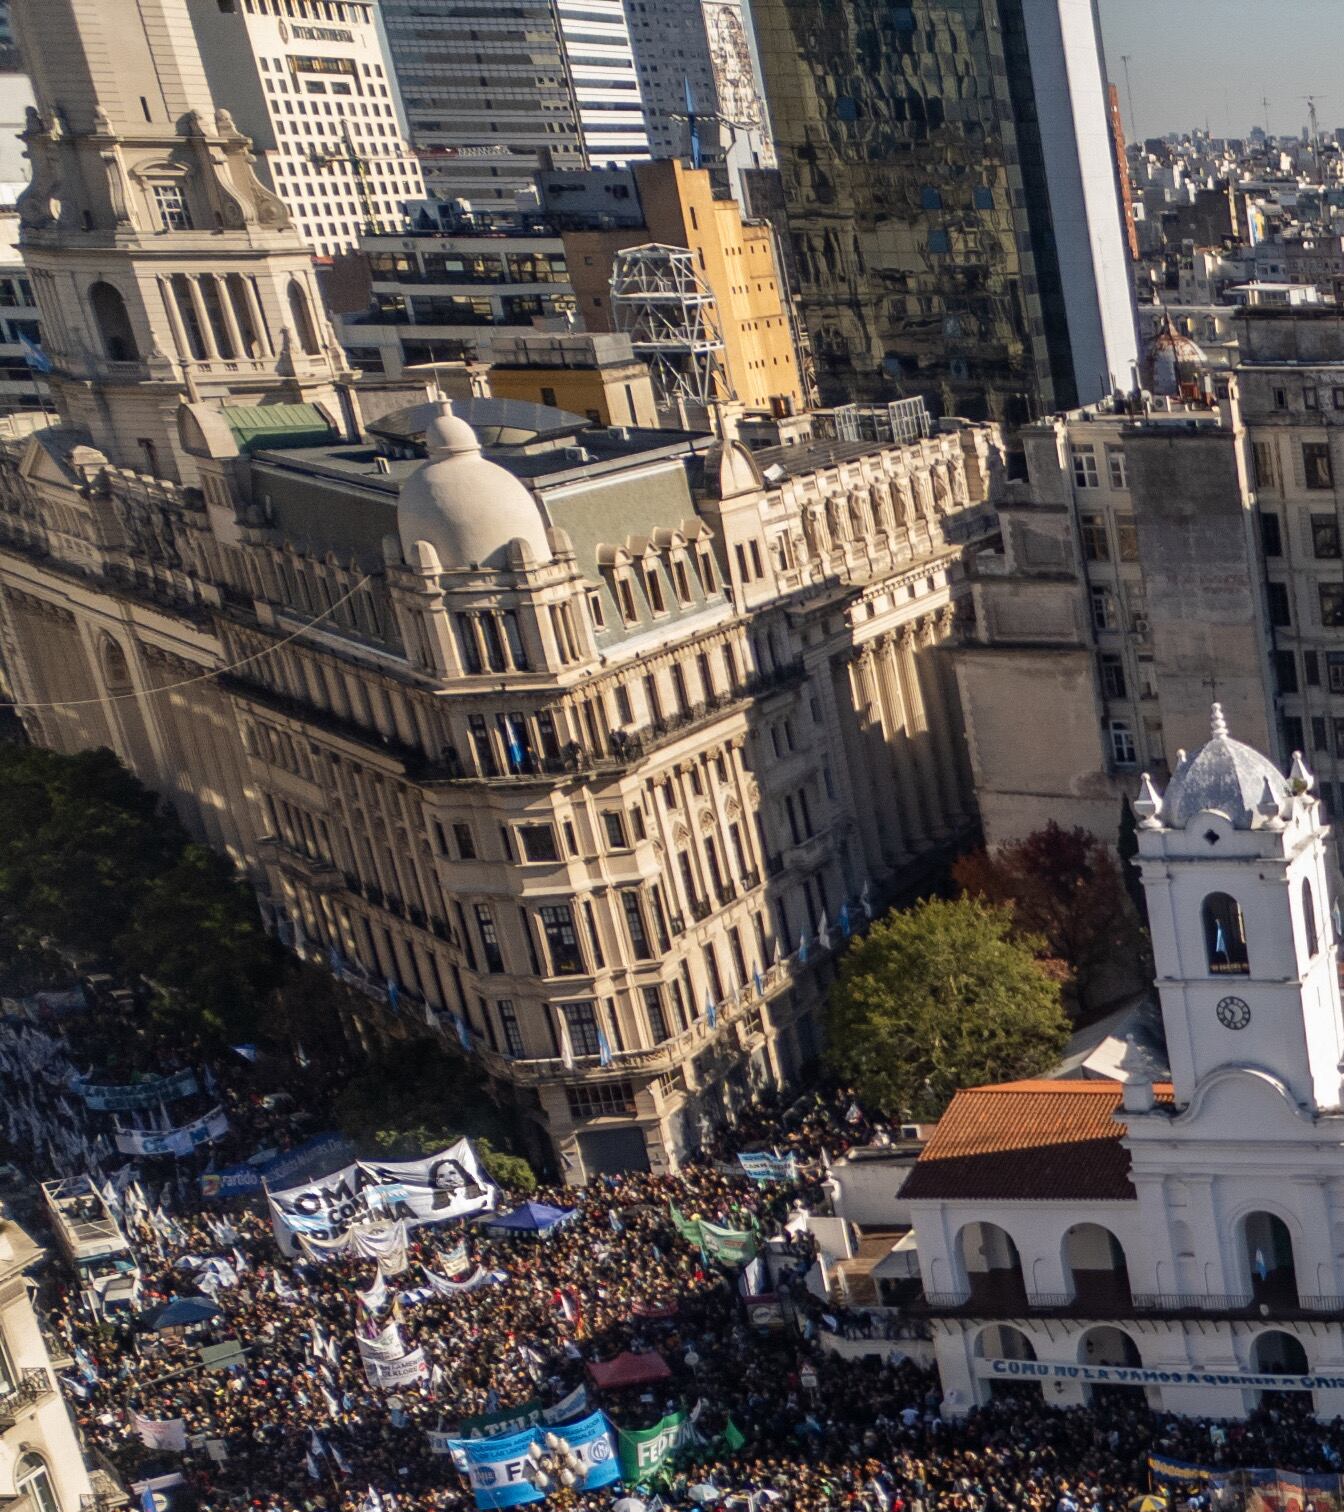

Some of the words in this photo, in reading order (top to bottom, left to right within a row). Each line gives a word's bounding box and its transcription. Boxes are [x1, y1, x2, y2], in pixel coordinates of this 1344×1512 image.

[993, 1360, 1050, 1377] COMO
[1054, 1362, 1079, 1377] NO
[1114, 1367, 1184, 1384] VAMOS
[1186, 1370, 1199, 1384] A
